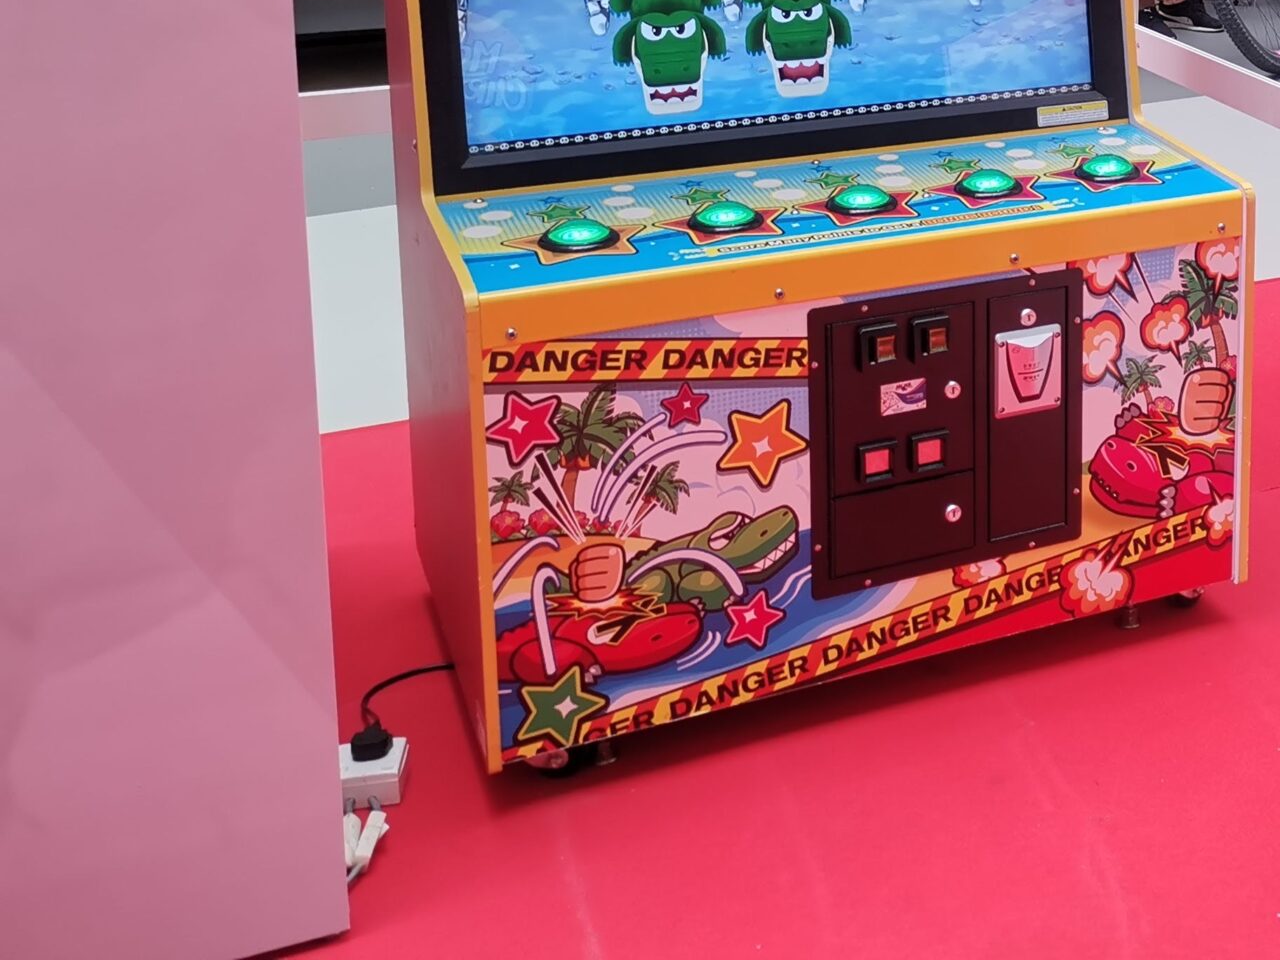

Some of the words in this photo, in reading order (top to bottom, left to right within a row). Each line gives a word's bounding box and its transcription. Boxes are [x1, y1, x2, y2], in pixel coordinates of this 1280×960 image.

[488, 348, 649, 374] DANGER
[660, 347, 809, 371] DANGER
[669, 656, 811, 720] DANGER
[821, 606, 954, 666] DANGER
[962, 565, 1065, 616] DANGE
[1106, 516, 1207, 561] ANGER
